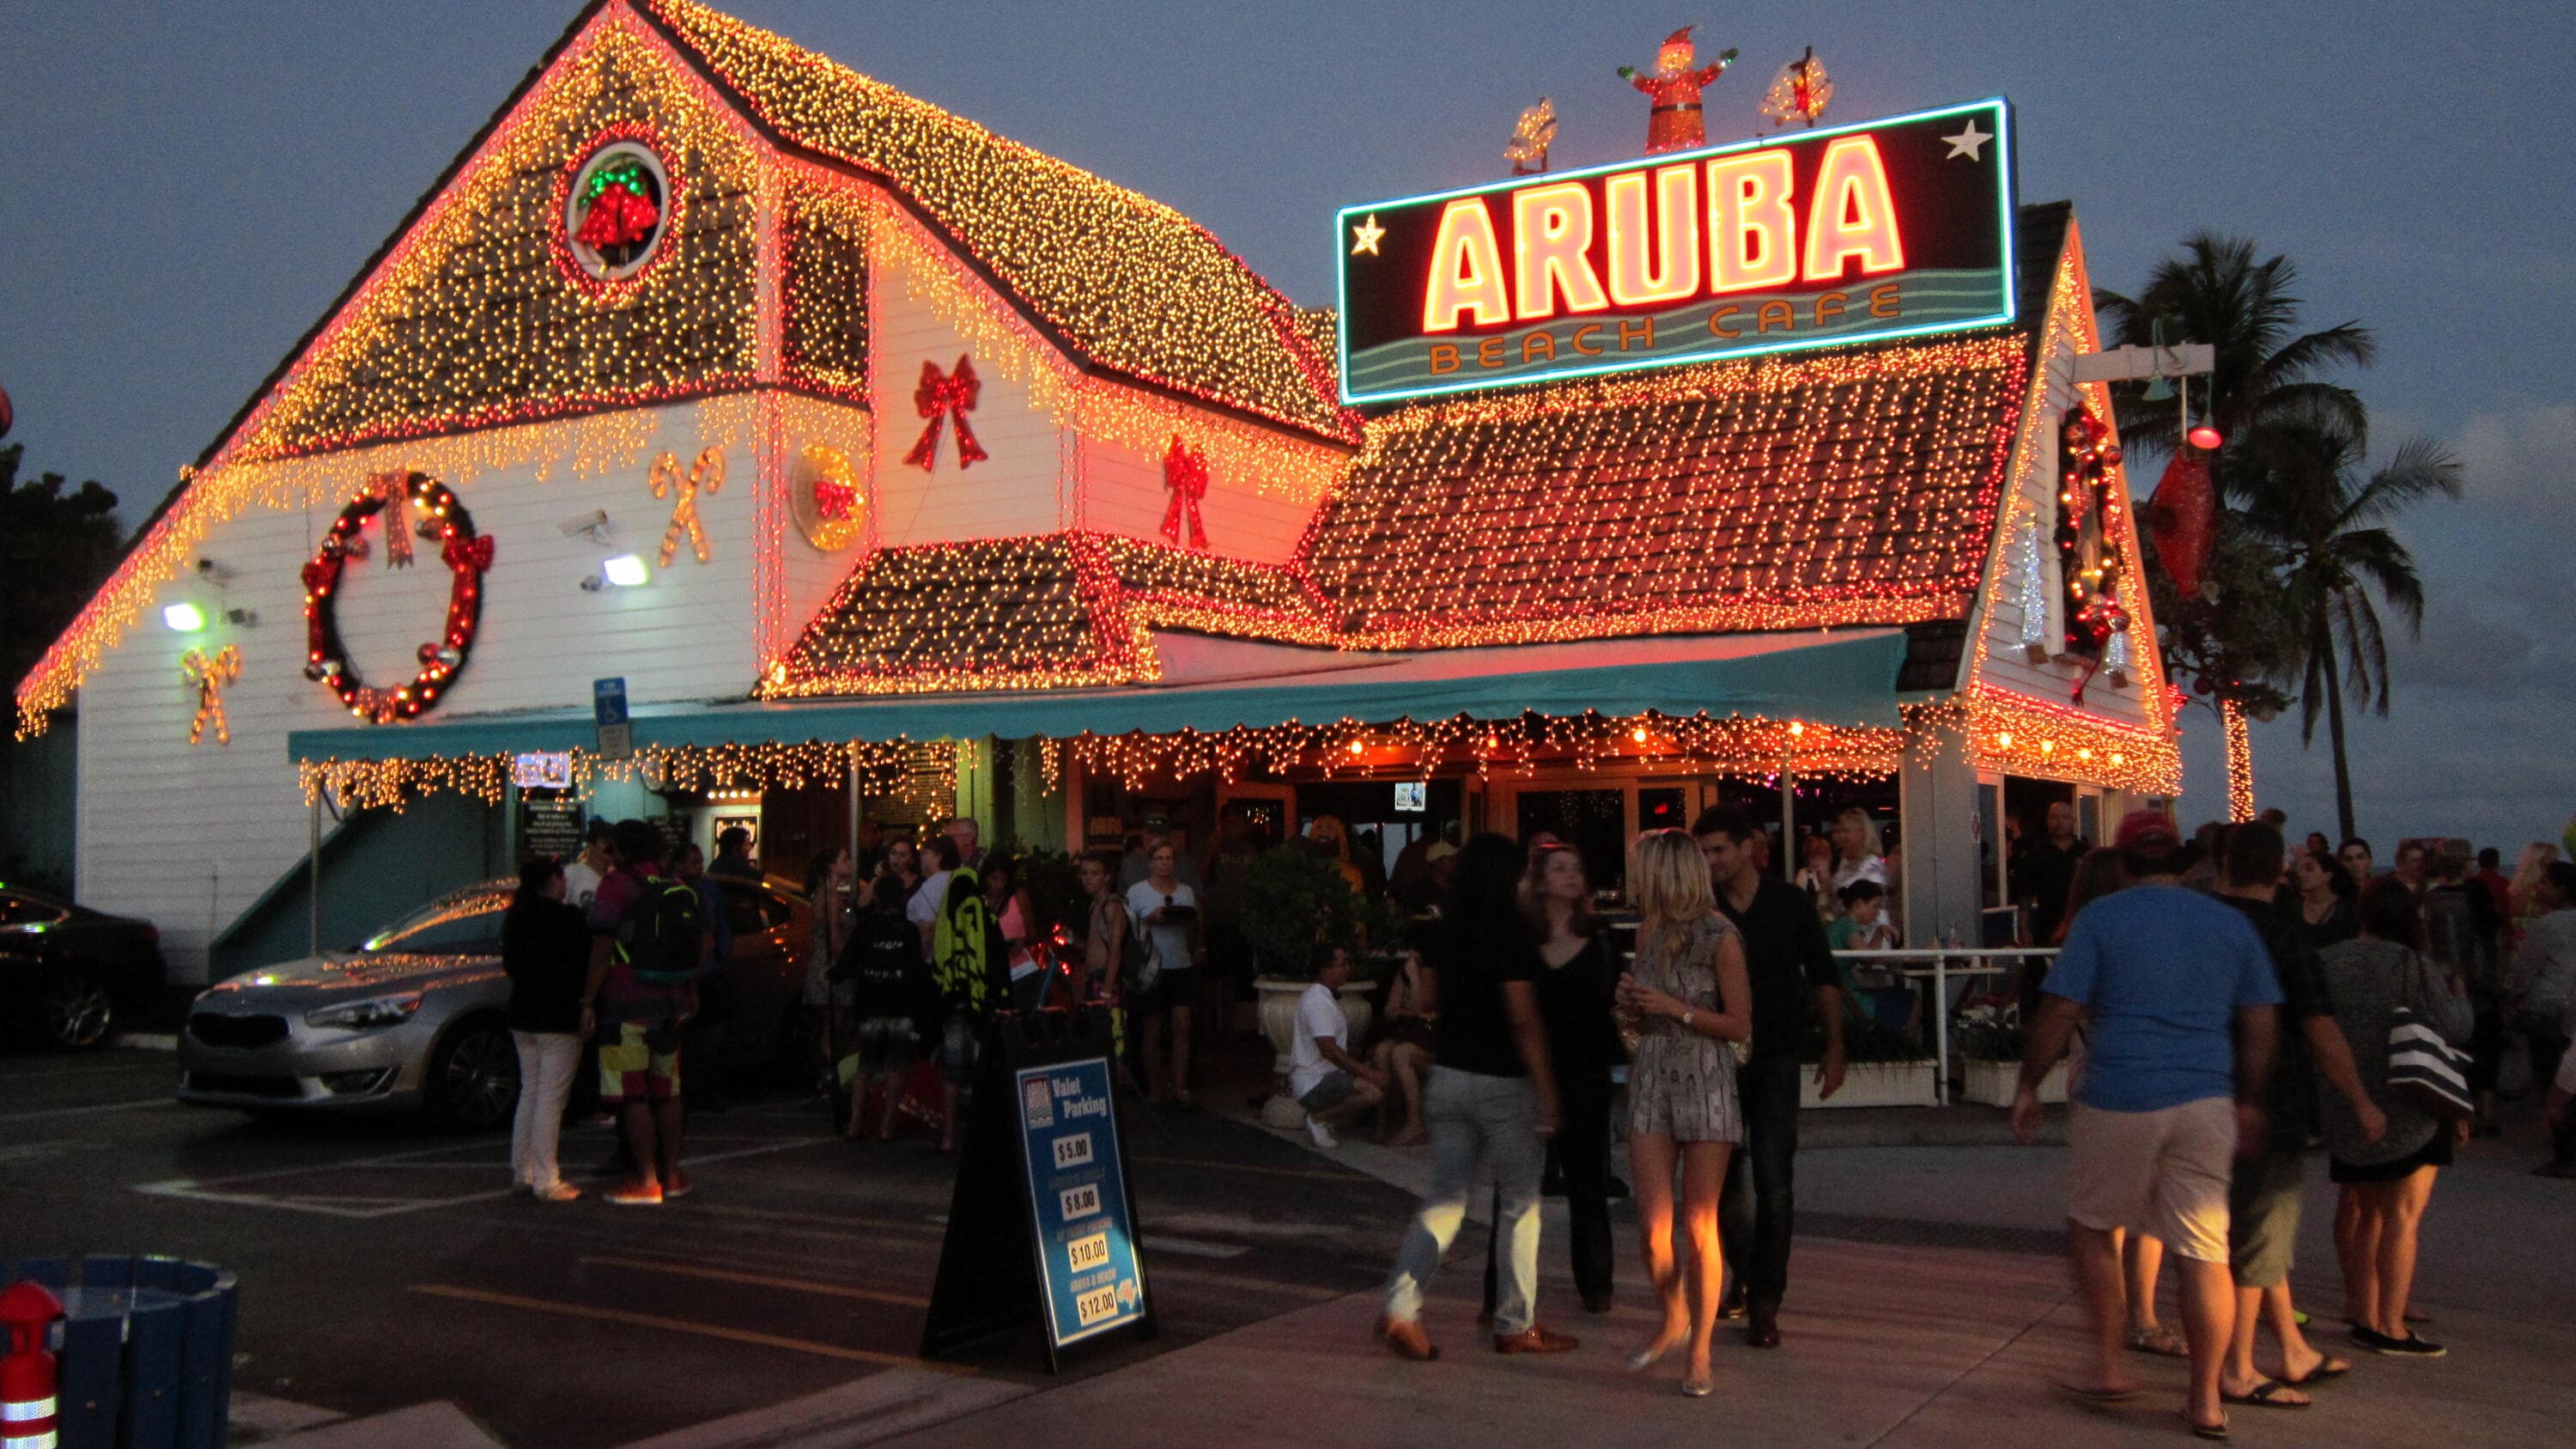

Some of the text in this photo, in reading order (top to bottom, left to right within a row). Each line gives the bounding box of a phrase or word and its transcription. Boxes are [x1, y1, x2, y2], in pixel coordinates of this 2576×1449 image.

[1422, 133, 1905, 333] ARUBA
[1429, 283, 1901, 376] BEACH CAFE
[1052, 1076, 1081, 1098] Valet
[1063, 1096, 1107, 1118] Parking
